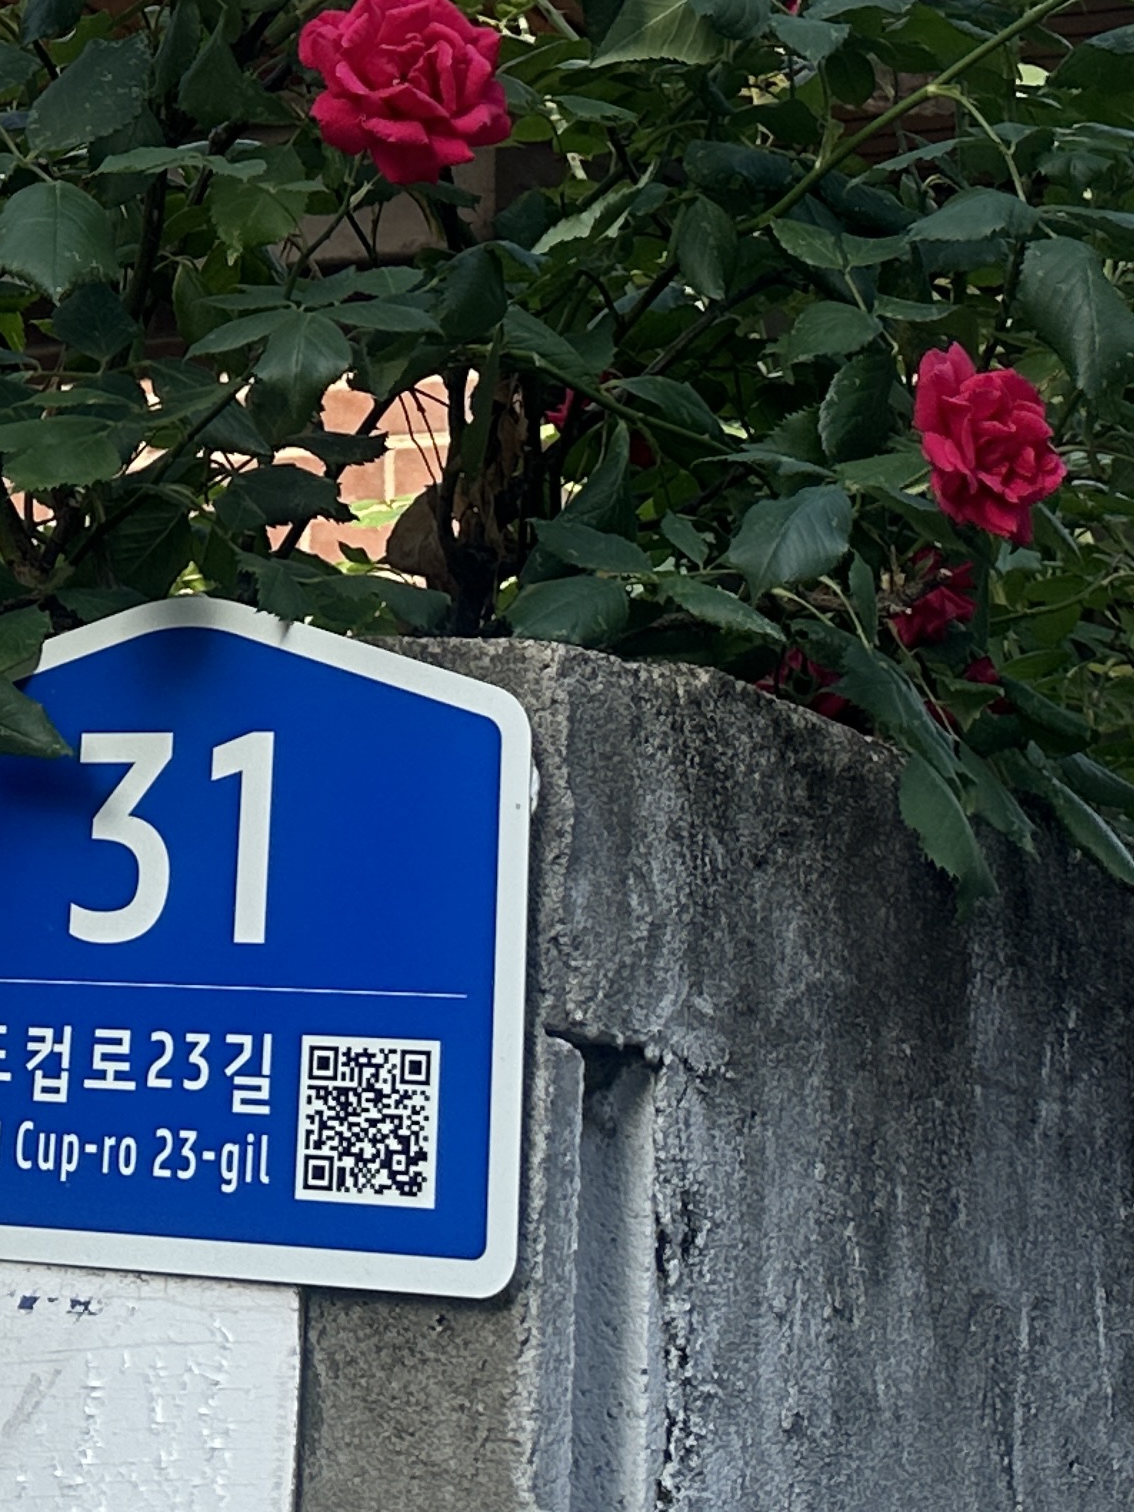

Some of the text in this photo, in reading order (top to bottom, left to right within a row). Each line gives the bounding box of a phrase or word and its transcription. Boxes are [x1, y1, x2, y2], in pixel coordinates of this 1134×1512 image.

[68, 730, 275, 944] 31
[15, 1120, 137, 1182] Cup-ro
[152, 1128, 270, 1194] 23-gil
